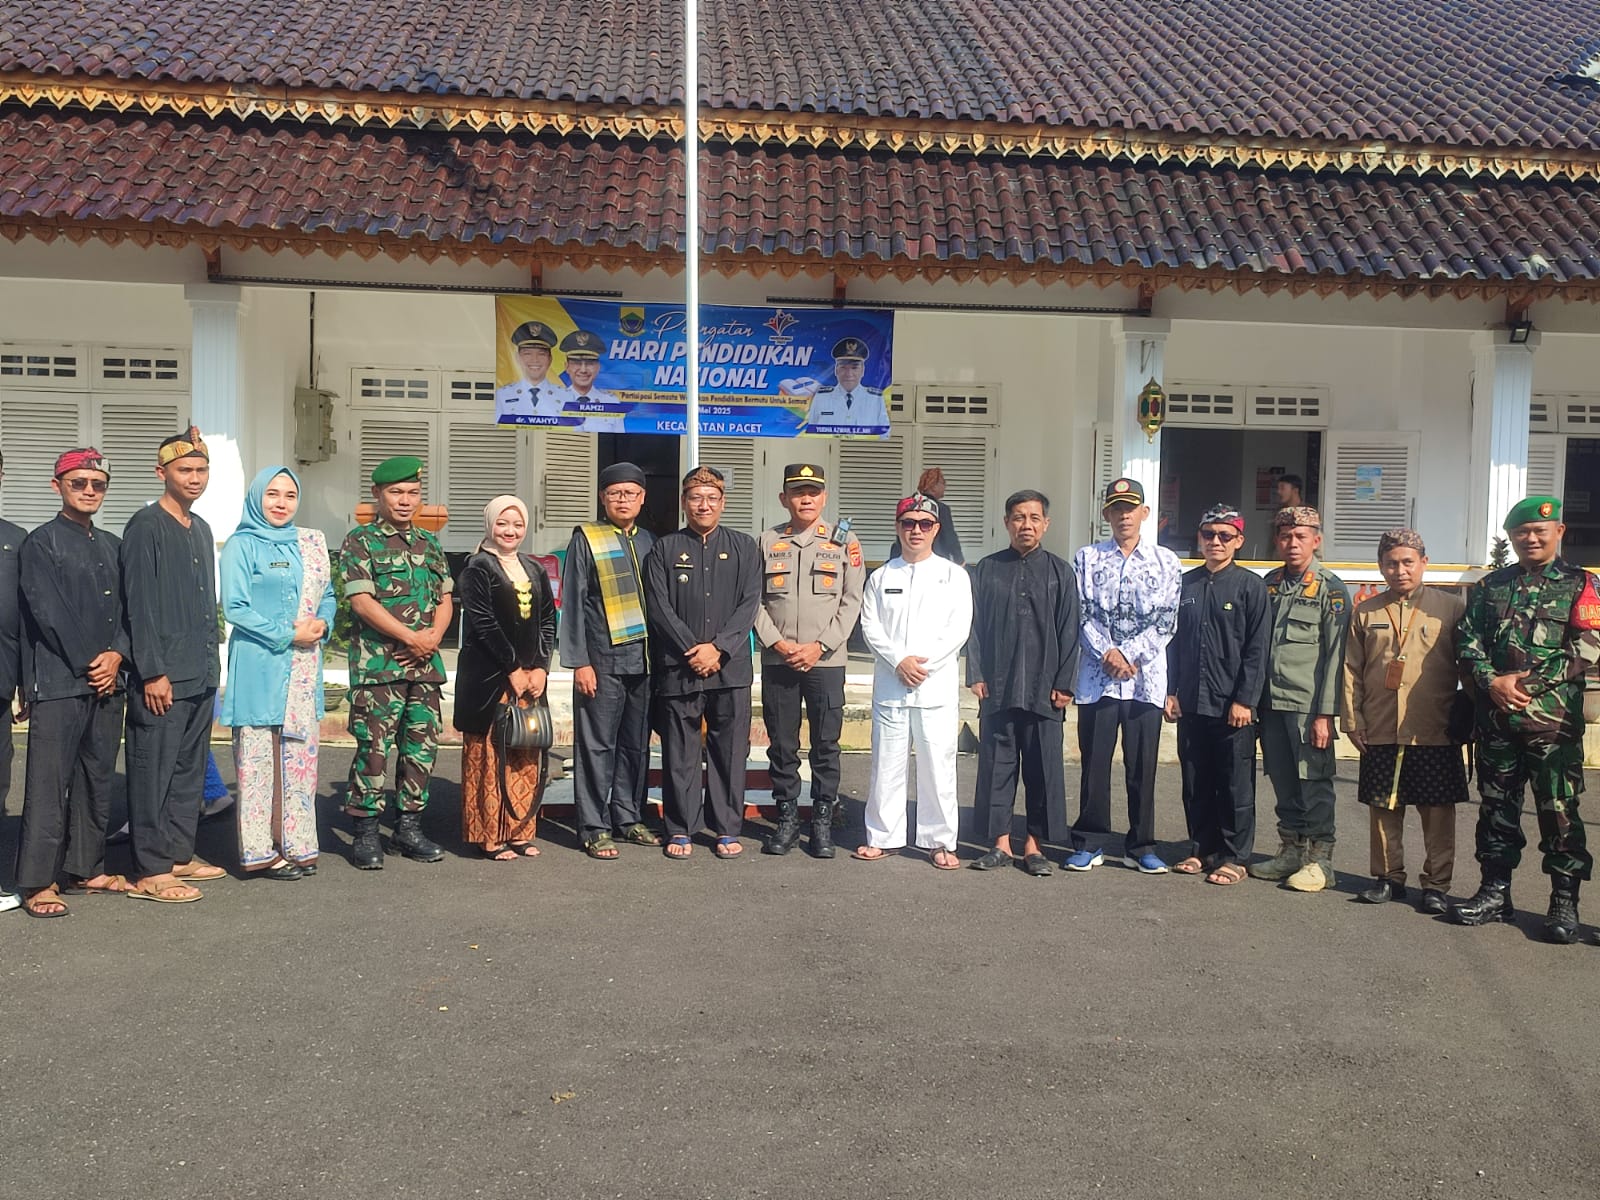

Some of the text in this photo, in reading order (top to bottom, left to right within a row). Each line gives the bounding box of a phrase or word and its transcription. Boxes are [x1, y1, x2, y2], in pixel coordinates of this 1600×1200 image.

[609, 339, 814, 366] HARI PNDIDIKAN
[653, 365, 769, 388] NAIONAL
[579, 404, 605, 412] RAMZI
[713, 407, 731, 415] 2025
[528, 417, 559, 425] WAHYU
[657, 420, 763, 433] KECAATAN PACET
[816, 552, 841, 560] POLRI
